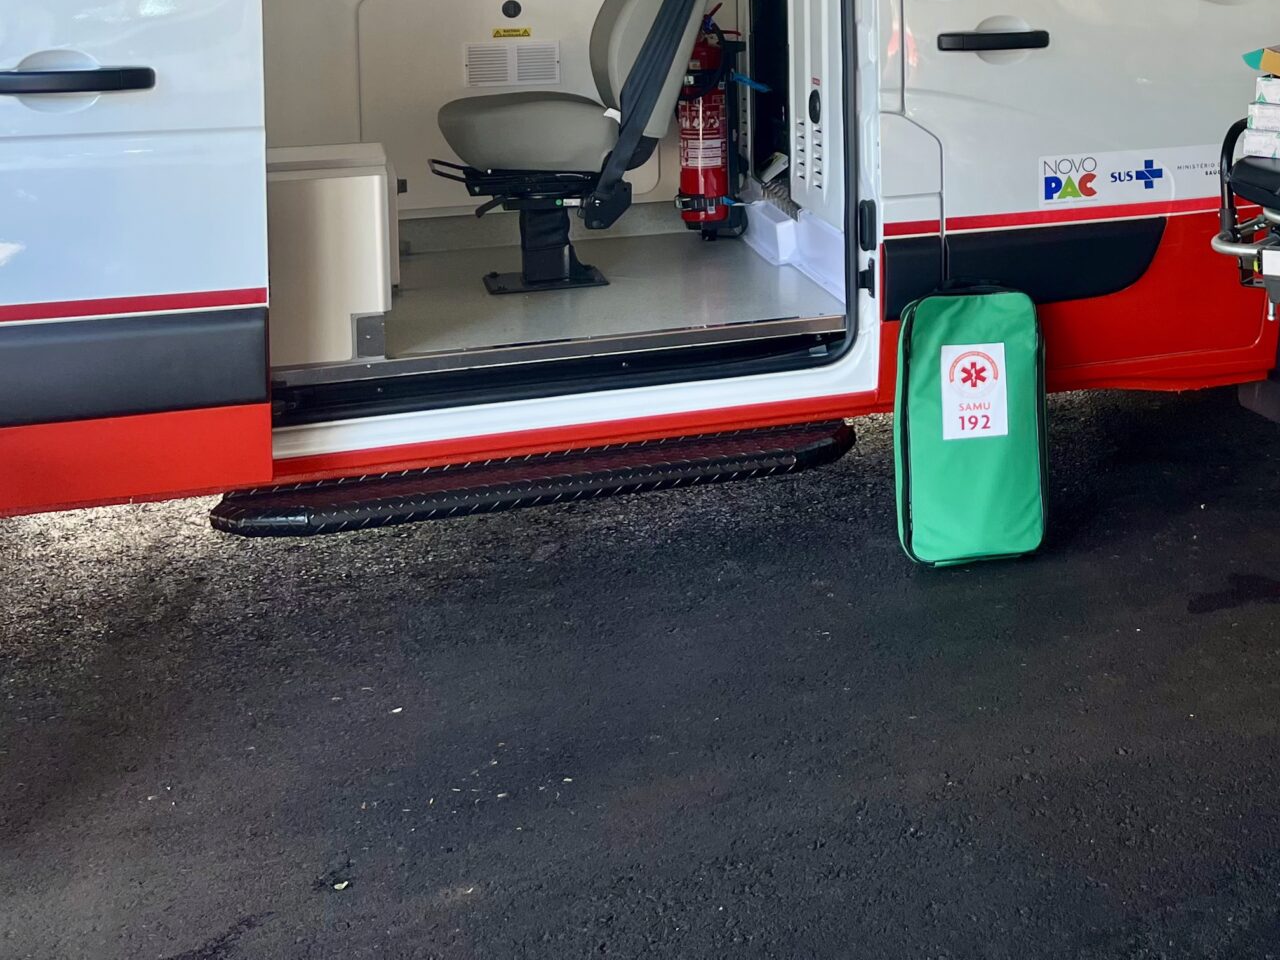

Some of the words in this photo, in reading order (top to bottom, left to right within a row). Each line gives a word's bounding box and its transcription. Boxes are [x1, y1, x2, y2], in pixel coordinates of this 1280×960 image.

[1043, 157, 1097, 176] NOVO
[1177, 162, 1215, 171] MINISTÉRIO
[1110, 171, 1133, 182] SUS
[1044, 173, 1098, 200] PAC
[959, 402, 991, 411] SAMU
[959, 414, 991, 430] 192
